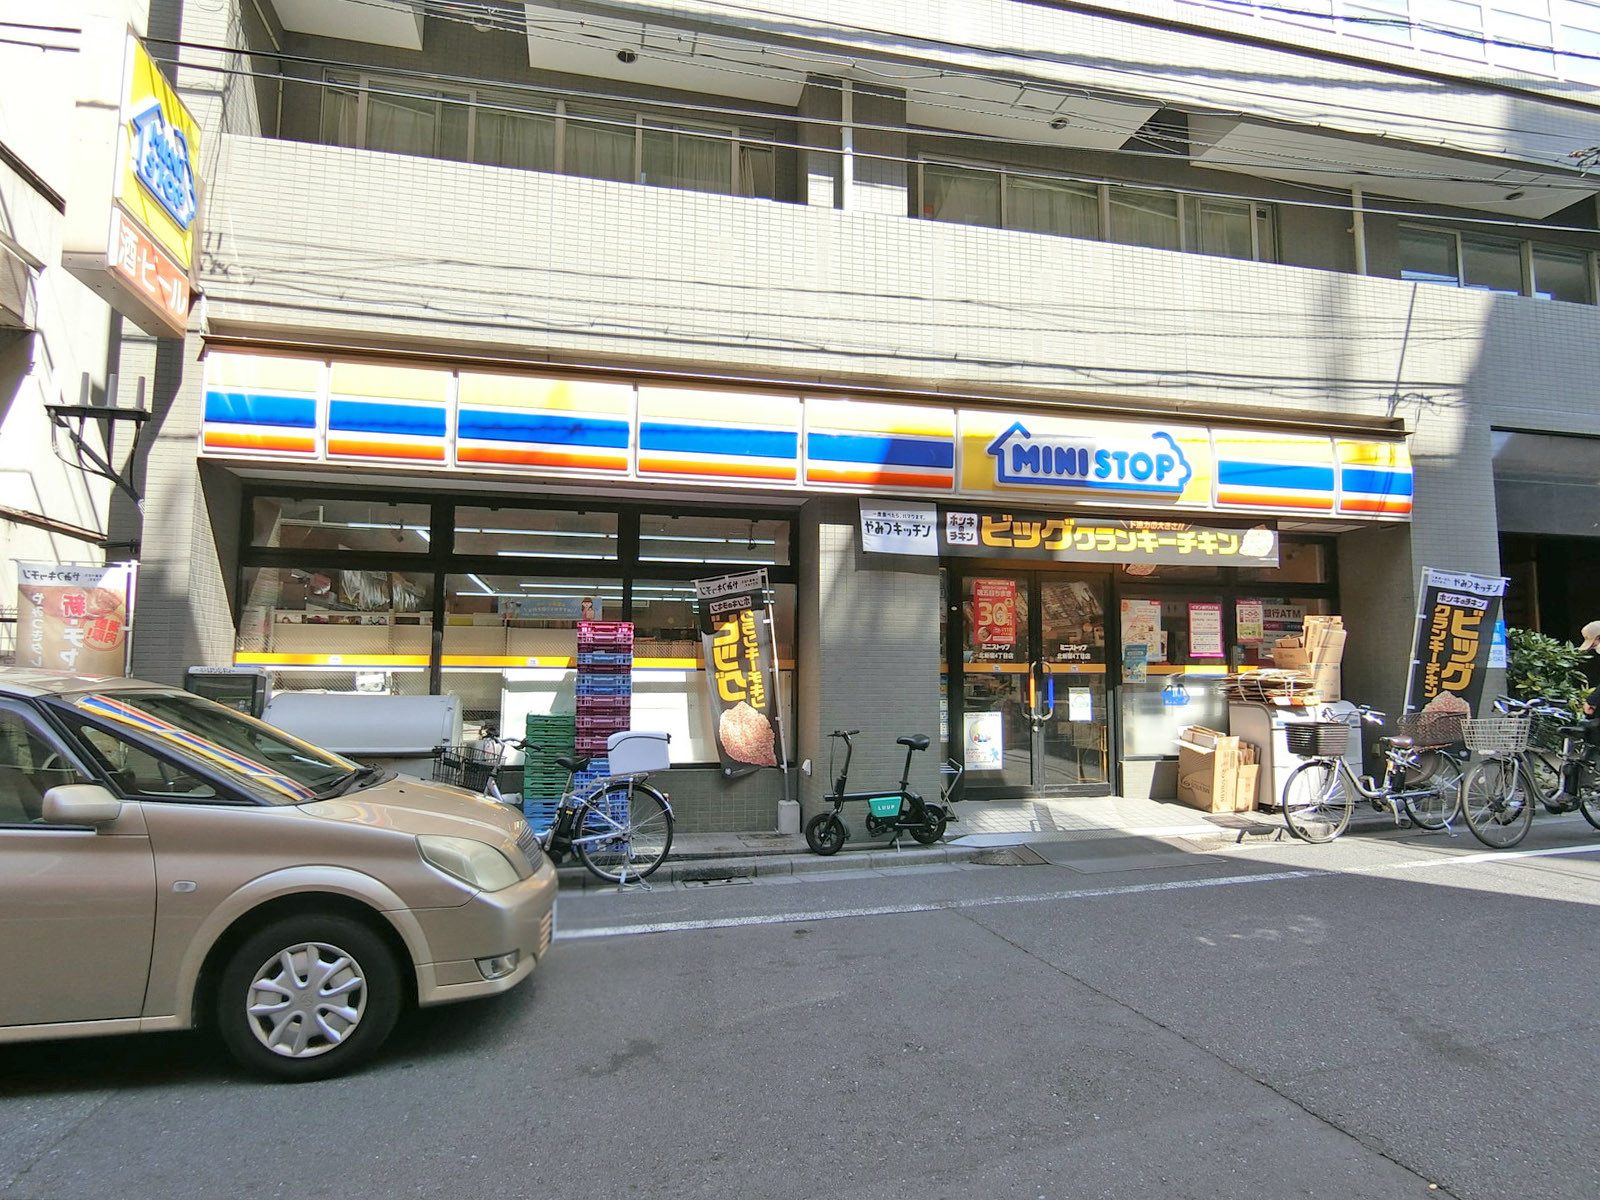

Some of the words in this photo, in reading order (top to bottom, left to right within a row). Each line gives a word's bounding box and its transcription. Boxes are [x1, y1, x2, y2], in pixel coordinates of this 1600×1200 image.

[149, 120, 184, 183] MINI
[145, 154, 185, 210] STOP
[1012, 443, 1089, 477] MINI
[1094, 449, 1175, 482] STOP
[864, 520, 932, 538] やみつキッチン
[949, 514, 975, 527] ホンキ
[949, 531, 975, 542] チキン
[1453, 577, 1501, 593] やみつキッチン
[1439, 593, 1486, 608] ホンキのチキン
[1424, 604, 1451, 698] クランキーチキン
[1441, 608, 1485, 691] ビッグ
